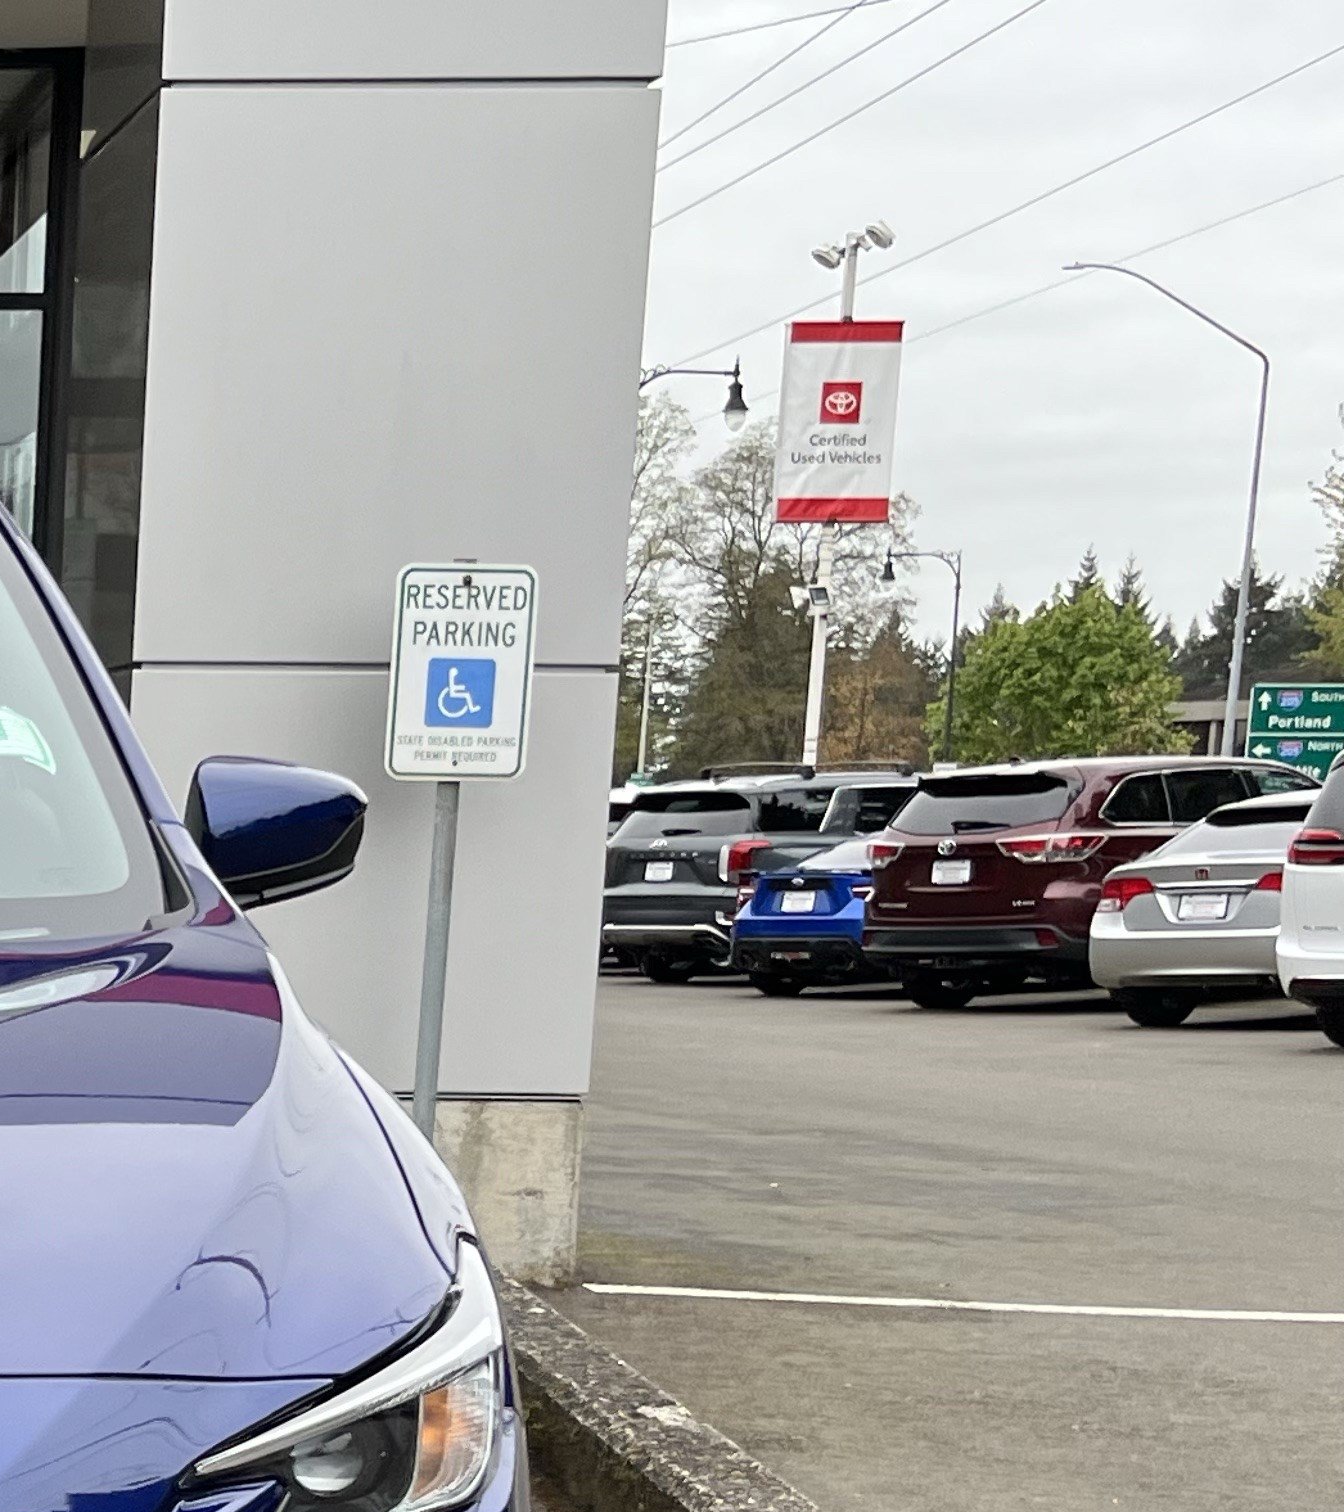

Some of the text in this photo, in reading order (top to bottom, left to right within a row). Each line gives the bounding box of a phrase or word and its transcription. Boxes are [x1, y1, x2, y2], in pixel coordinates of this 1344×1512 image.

[809, 434, 867, 447] Certified
[791, 451, 881, 464] Used Vehicles
[406, 584, 527, 611] RESERVED
[412, 621, 516, 647] PARKING
[1268, 715, 1332, 729] Portland
[397, 735, 516, 747] STATE DISABLED PARKING
[414, 750, 497, 762] PERMIT REQUIRED
